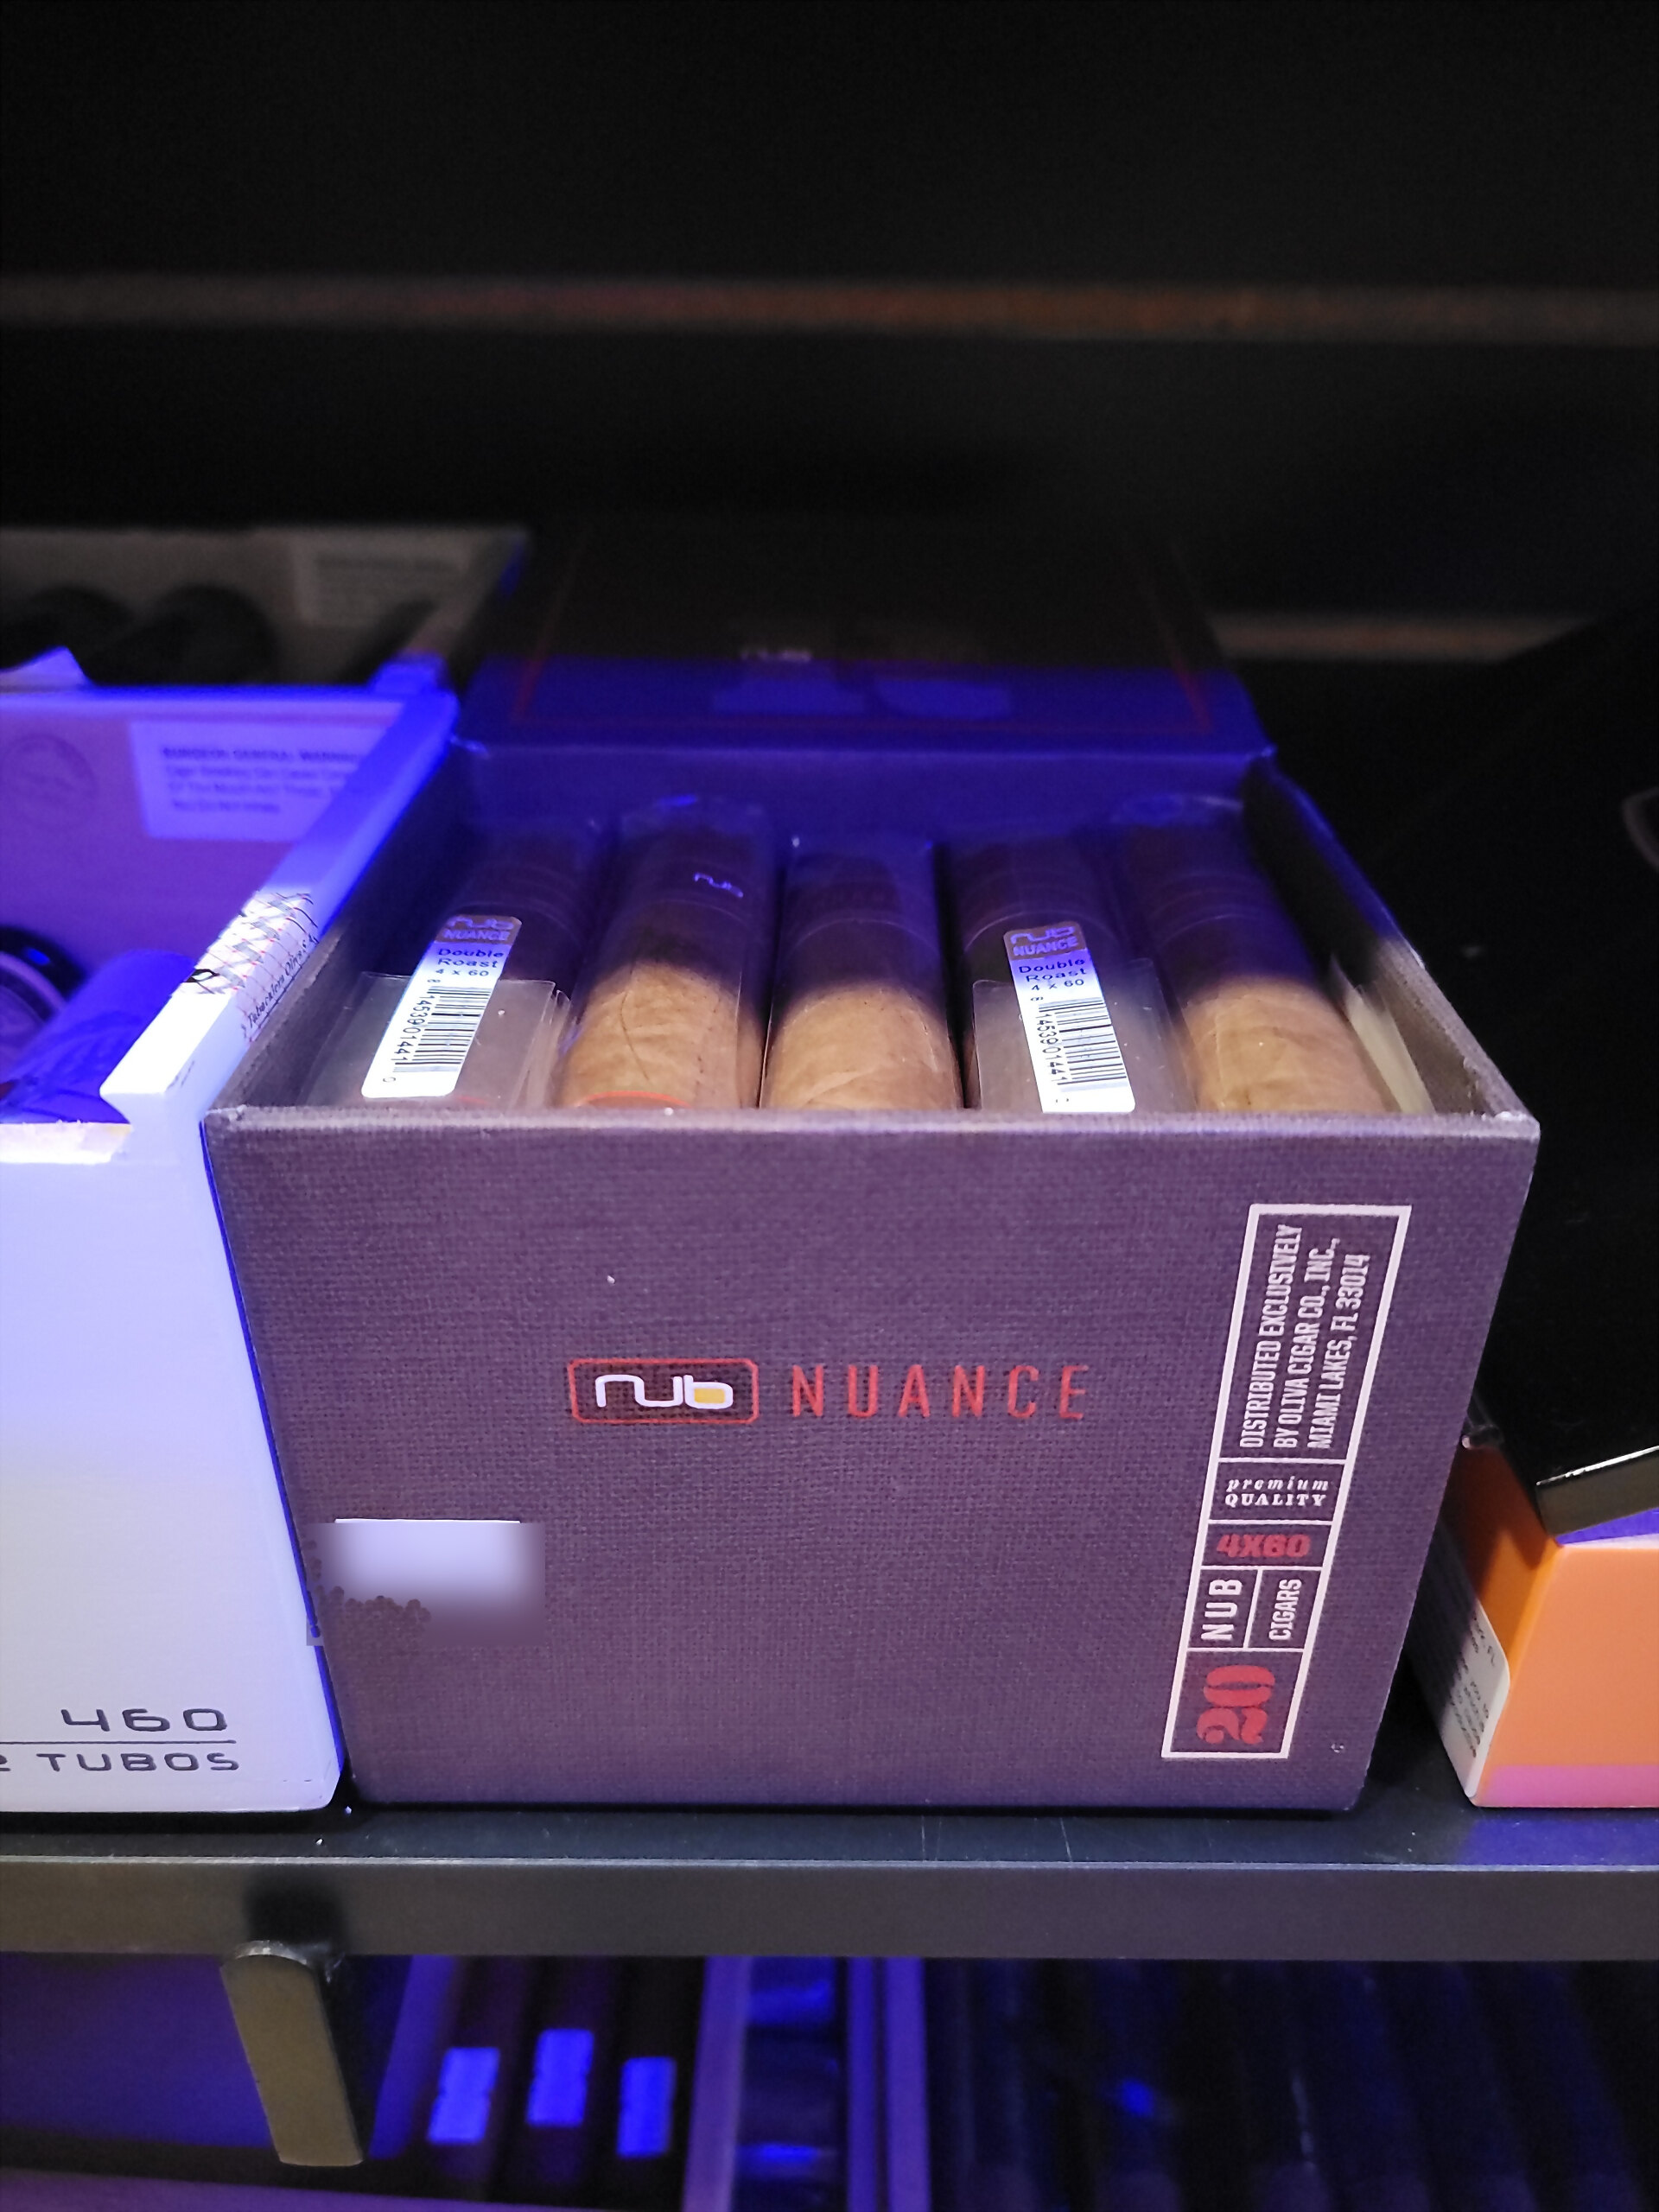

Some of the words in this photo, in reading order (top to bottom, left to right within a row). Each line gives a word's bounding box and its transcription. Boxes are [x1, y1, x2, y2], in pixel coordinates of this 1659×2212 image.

[442, 929, 511, 941] NUANCE
[1013, 936, 1078, 957] NUANCE
[438, 949, 504, 957] Double
[438, 958, 498, 968] Roast
[1019, 959, 1084, 974] Double
[1026, 968, 1087, 982] Roast
[1258, 1224, 1303, 1337] EXCLUSIVELY
[1336, 1253, 1371, 1310] 33014
[1330, 1313, 1358, 1332] FL
[1287, 1322, 1320, 1376] CIGAR
[1319, 1336, 1357, 1389] LAKES,
[594, 1374, 734, 1410] nub
[791, 1363, 1089, 1420] NUANCE
[1239, 1339, 1281, 1449] DISTRIBUTED
[1278, 1377, 1310, 1426] OLIVA
[1307, 1393, 1341, 1449] MIAMI
[1273, 1427, 1300, 1449] BY
[1225, 1476, 1329, 1492] premium
[1224, 1493, 1326, 1508] QUALITY
[1200, 1579, 1243, 1642] NUB
[1268, 1579, 1302, 1642] CIGARS
[1196, 1665, 1276, 1745] 20
[60, 1707, 228, 1732] 460
[35, 1752, 239, 1772] TUBOS
